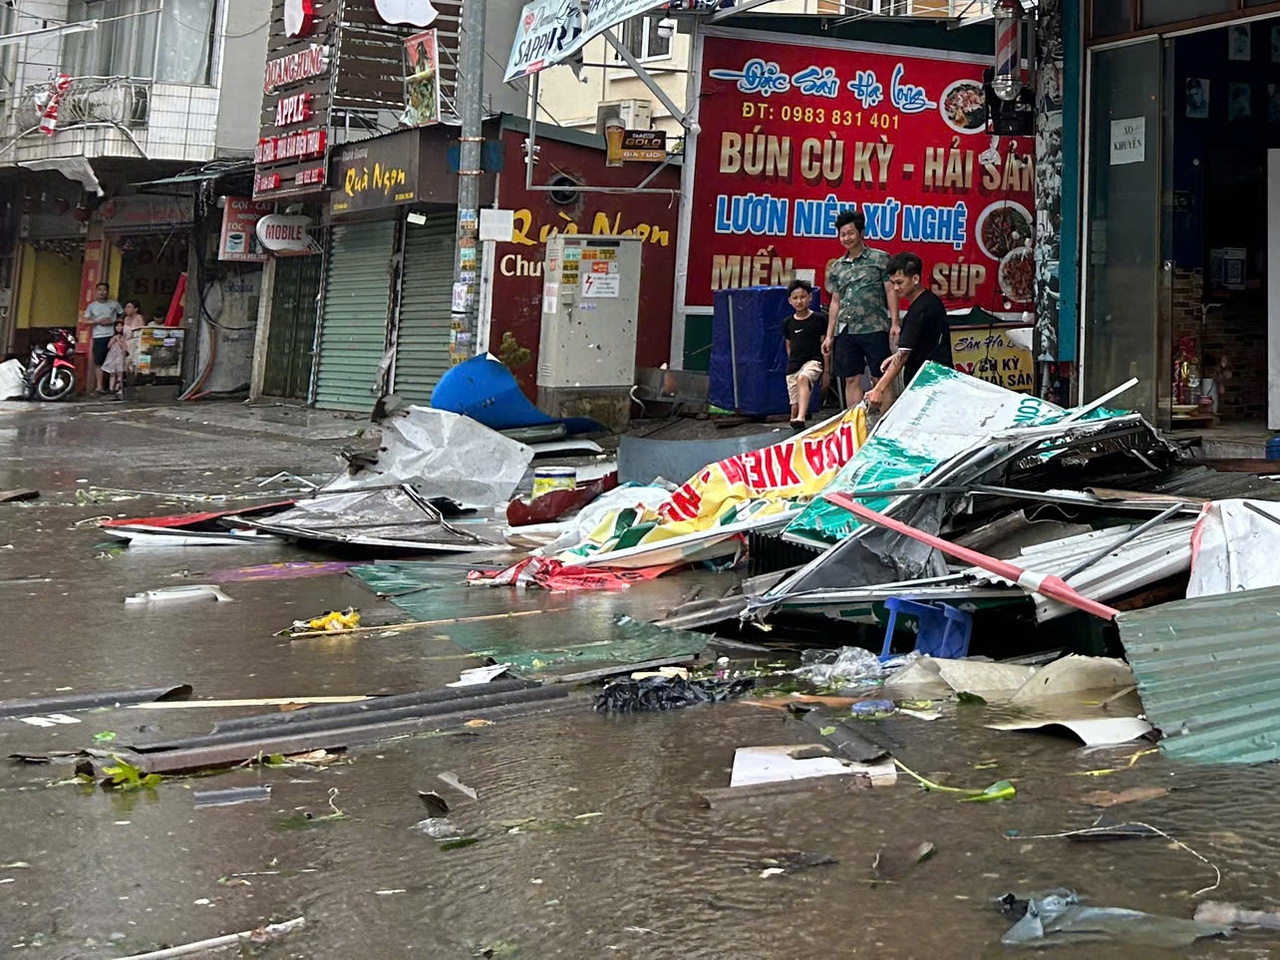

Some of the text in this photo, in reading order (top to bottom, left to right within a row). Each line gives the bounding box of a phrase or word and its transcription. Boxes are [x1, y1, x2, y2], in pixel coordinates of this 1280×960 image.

[275, 93, 306, 127] APPLE
[742, 102, 899, 130] ĐT: 0983 831 401
[625, 138, 661, 146] GOLD
[719, 125, 791, 176] BÚN
[801, 131, 844, 180] CÙ
[853, 134, 894, 182] KỲ
[924, 135, 973, 188] HẢI
[345, 166, 368, 197] Quà
[373, 162, 405, 195] Ngon
[265, 224, 303, 241] MOBILE
[592, 210, 670, 247] Non
[715, 193, 968, 251] LƯƠN NIÊ XỨ NGHỆ
[500, 254, 546, 277] Chu
[711, 245, 795, 290] MIẾN
[931, 256, 986, 298] SÚP
[1003, 355, 1020, 371] KỲ
[1007, 370, 1033, 387] SẢN
